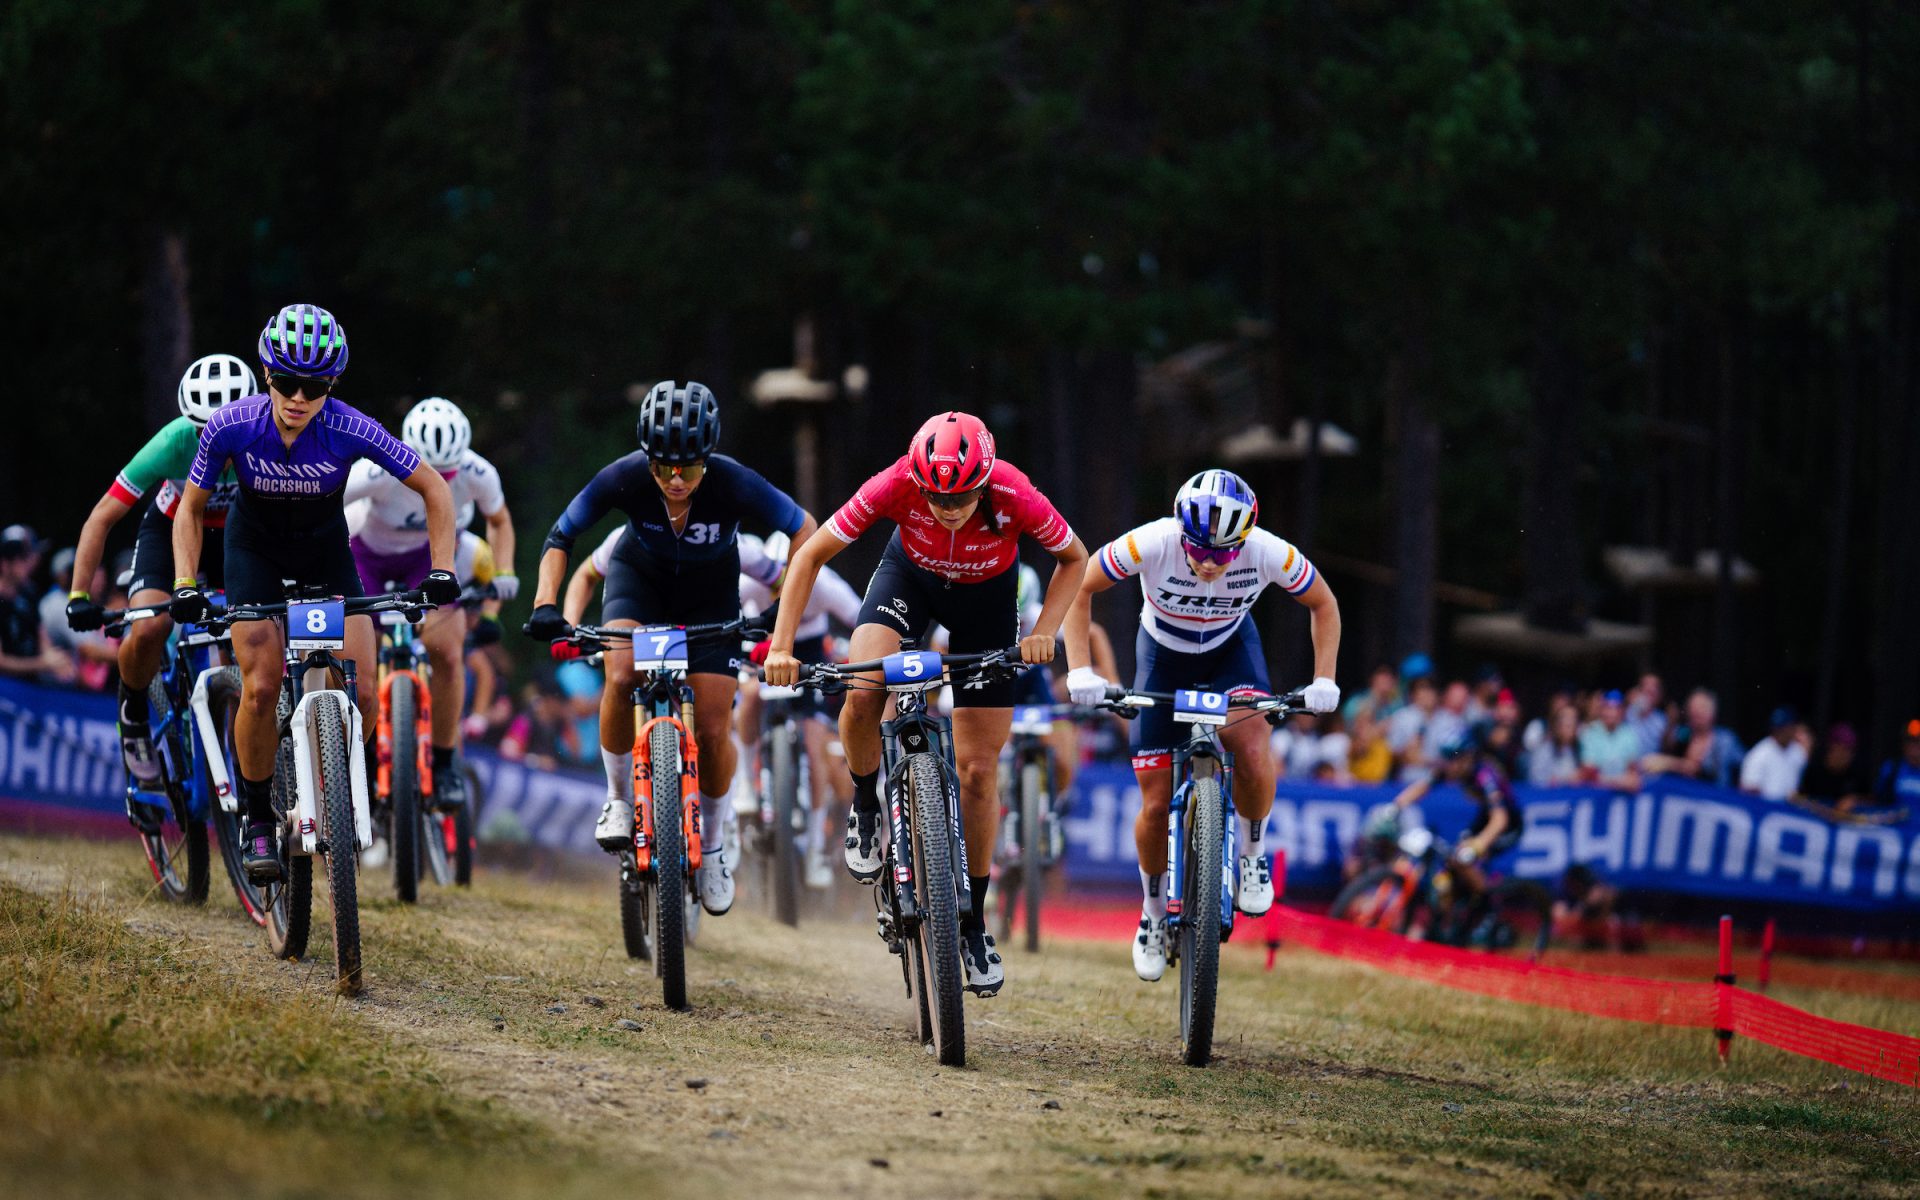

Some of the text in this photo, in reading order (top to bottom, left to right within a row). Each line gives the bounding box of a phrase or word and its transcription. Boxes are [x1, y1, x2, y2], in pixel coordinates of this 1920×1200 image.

[246, 451, 338, 478] CANYON
[253, 475, 321, 494] ROCKSHOX
[992, 483, 1017, 495] maxon
[1166, 576, 1198, 588] Santini
[1224, 567, 1257, 578] SRAM
[1226, 577, 1259, 591] ROCKSHOX
[1156, 599, 1250, 616] FACTORY RACIN
[1157, 587, 1259, 608] TREK
[306, 608, 327, 634] 8
[876, 604, 910, 631] maxon
[649, 634, 670, 656] 7
[902, 654, 924, 678] 5
[1184, 690, 1223, 710] 10
[1137, 748, 1169, 758] Santini
[1131, 757, 1161, 770] EK
[691, 801, 700, 834] FOX
[891, 844, 899, 861] DT
[1514, 793, 1920, 899] SHIMAN
[958, 838, 971, 892] DT SWISS
